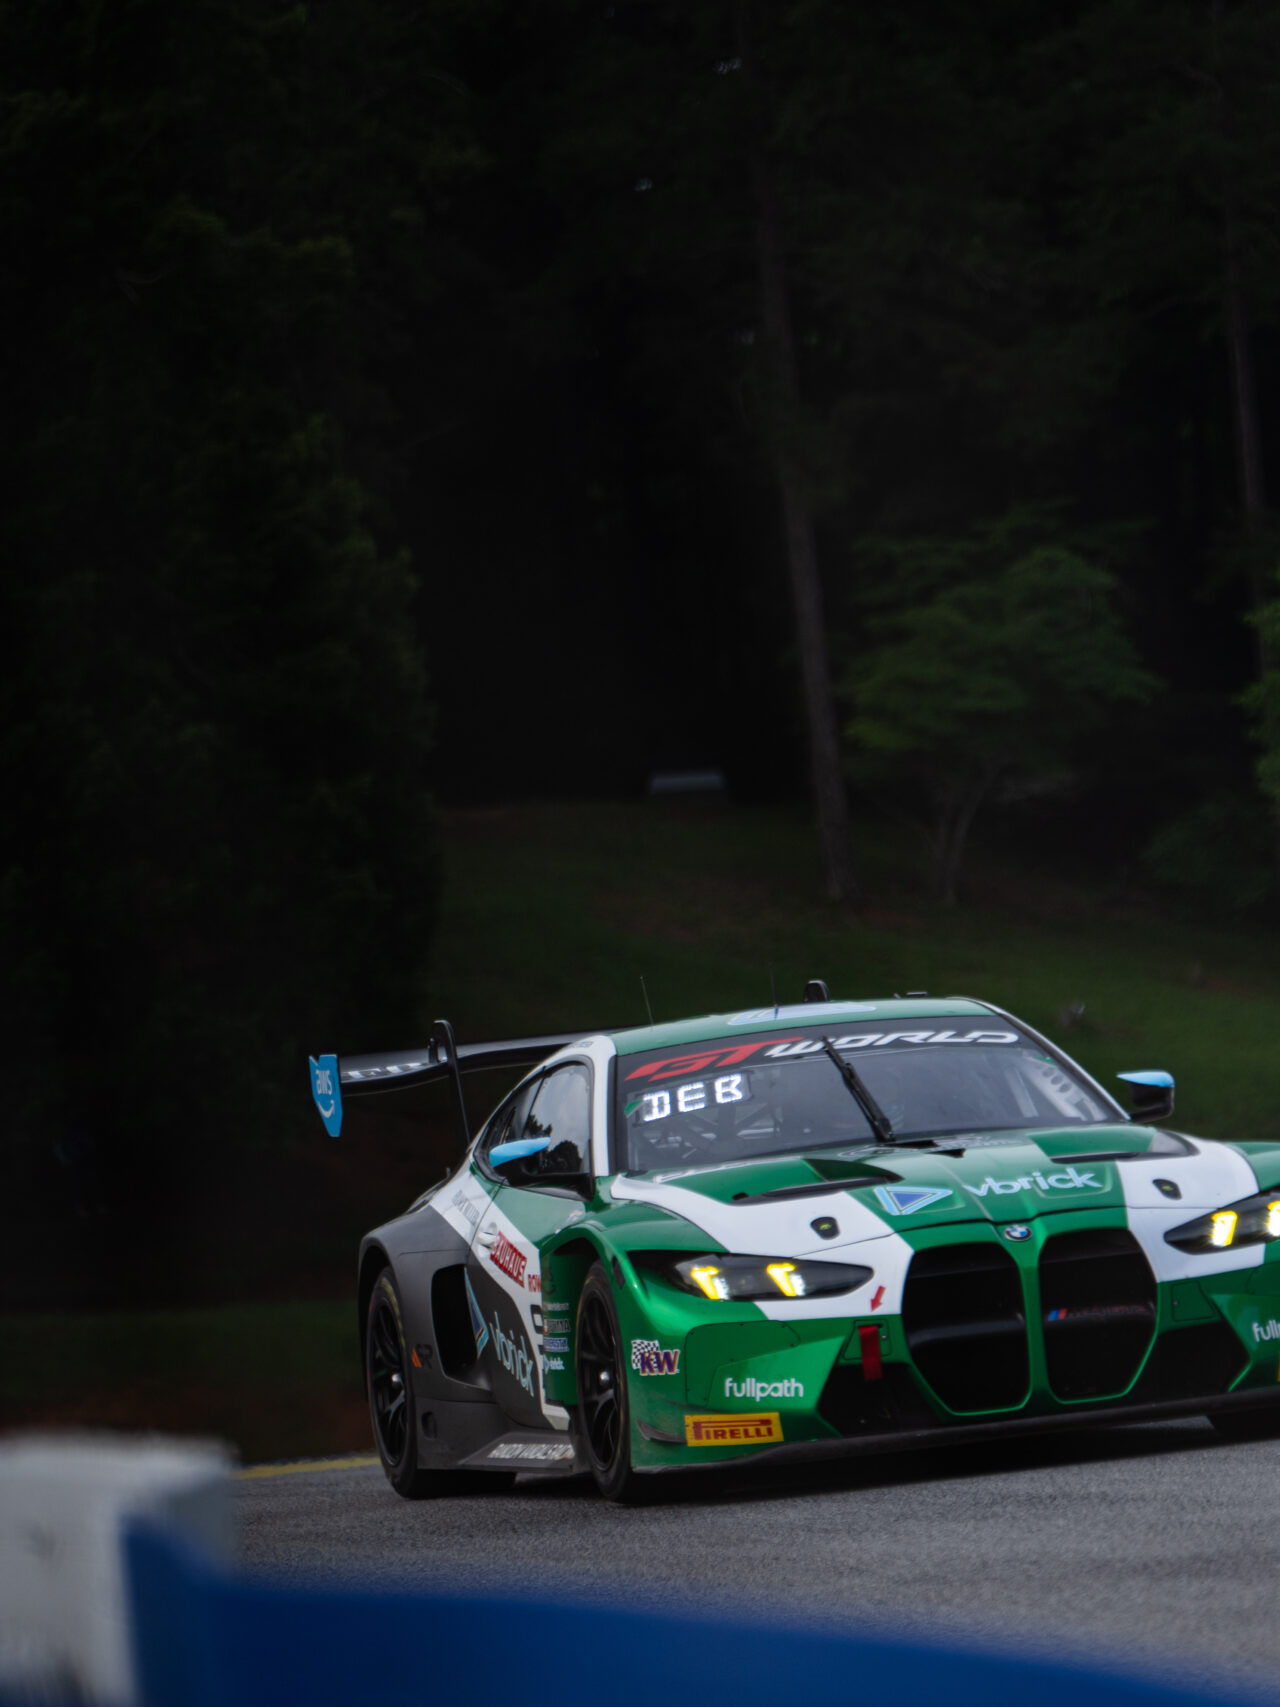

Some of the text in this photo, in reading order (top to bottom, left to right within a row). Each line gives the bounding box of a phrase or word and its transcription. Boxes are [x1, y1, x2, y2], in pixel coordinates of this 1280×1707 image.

[623, 1030, 1019, 1082] GT WORLD
[964, 1167, 1103, 1197] vbrick
[489, 1311, 534, 1398] vbrick
[640, 1350, 680, 1375] KW
[724, 1377, 804, 1403] fullpath
[692, 1419, 774, 1440] PIRELLI
